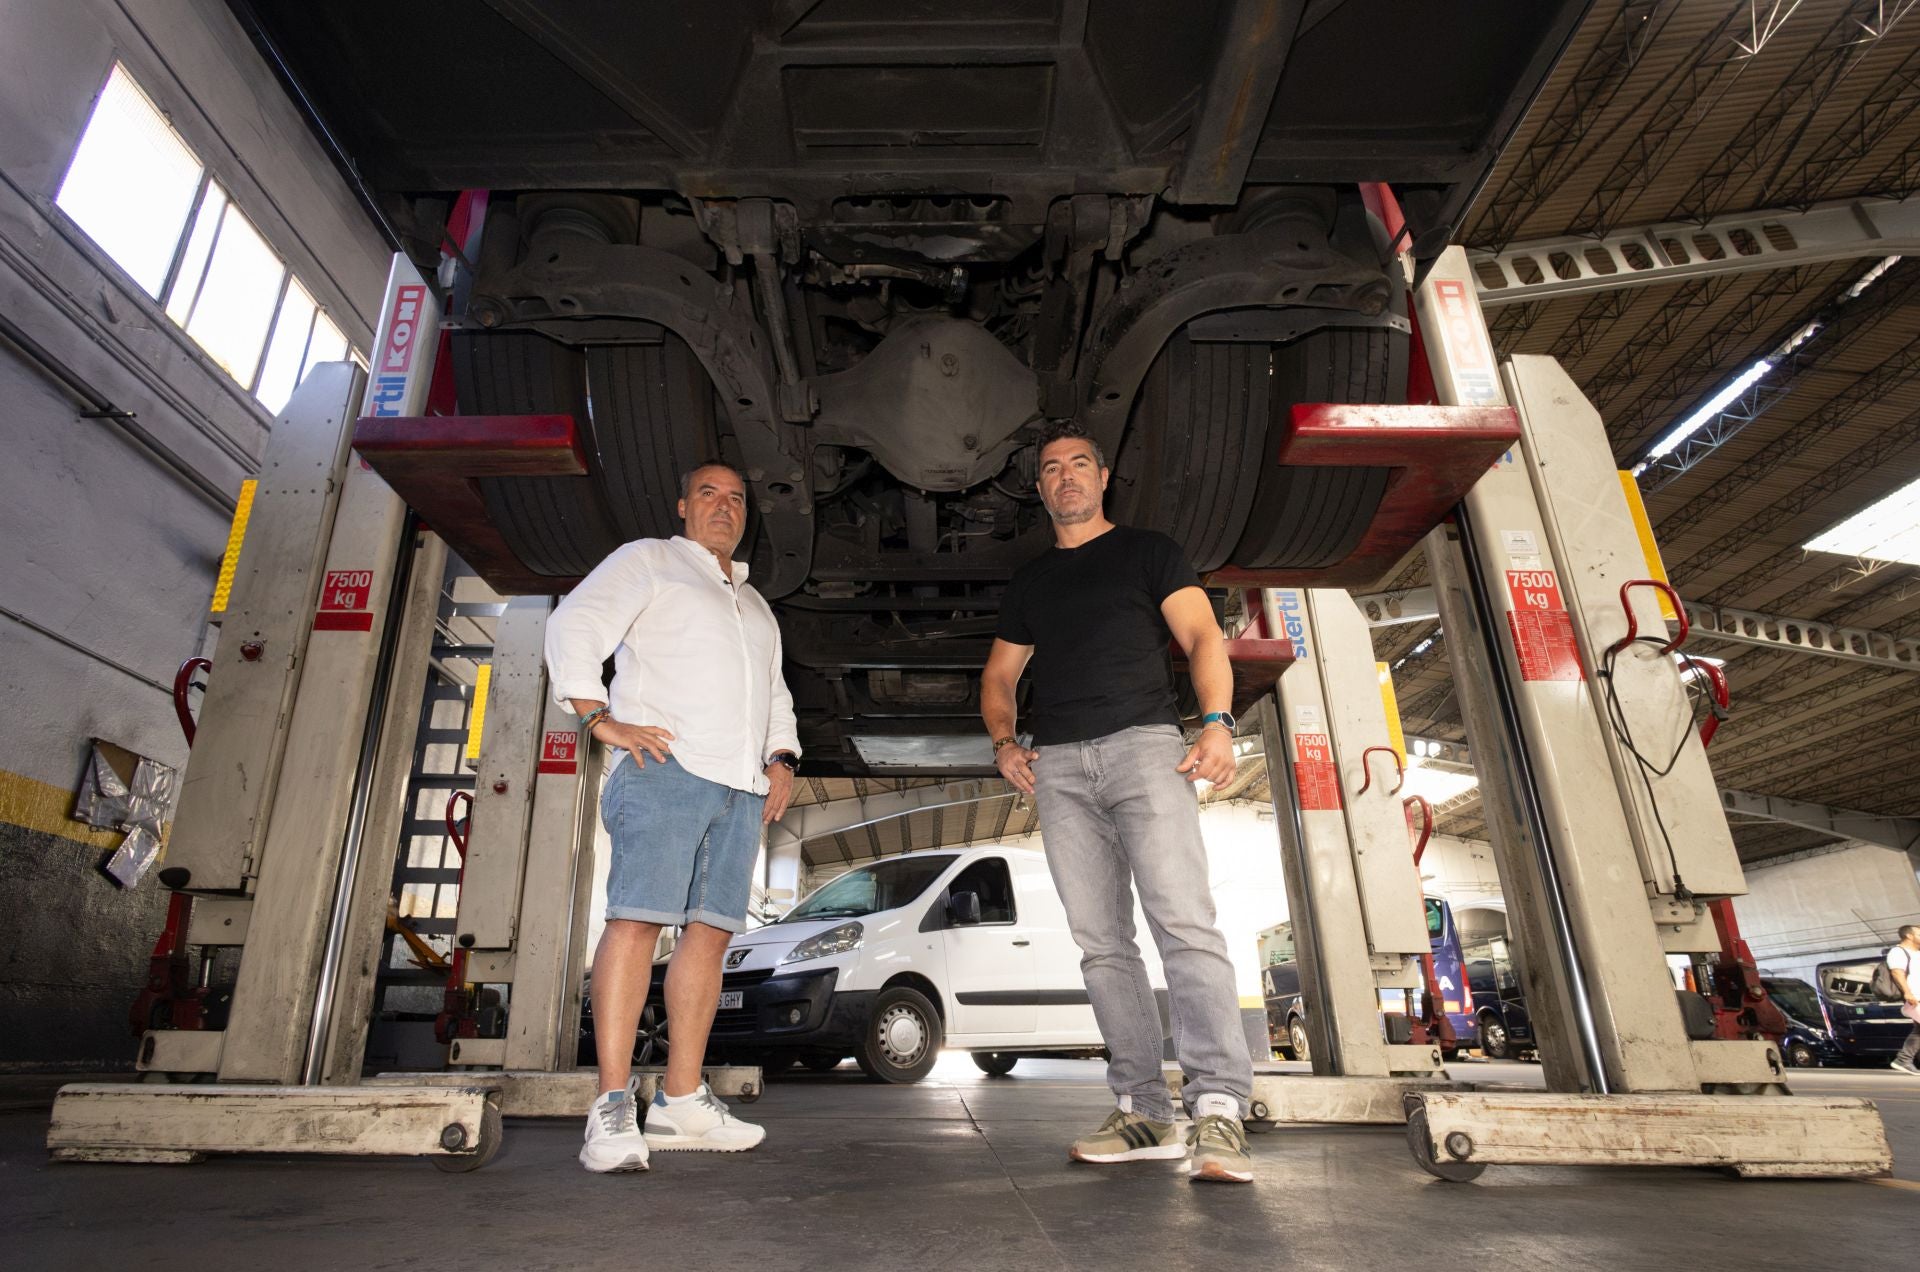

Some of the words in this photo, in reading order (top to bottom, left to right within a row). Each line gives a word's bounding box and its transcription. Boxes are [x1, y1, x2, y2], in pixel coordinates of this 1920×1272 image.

[387, 290, 419, 367] KONI
[373, 376, 407, 416] rtil
[329, 572, 371, 588] 7500
[1508, 572, 1554, 588] 7500
[334, 589, 356, 608] kg
[1524, 589, 1549, 609] kg
[547, 732, 576, 744] 7500
[1296, 735, 1327, 746] 7500
[552, 744, 567, 759] kg
[1306, 746, 1322, 761] kg
[724, 993, 741, 1007] GHY
